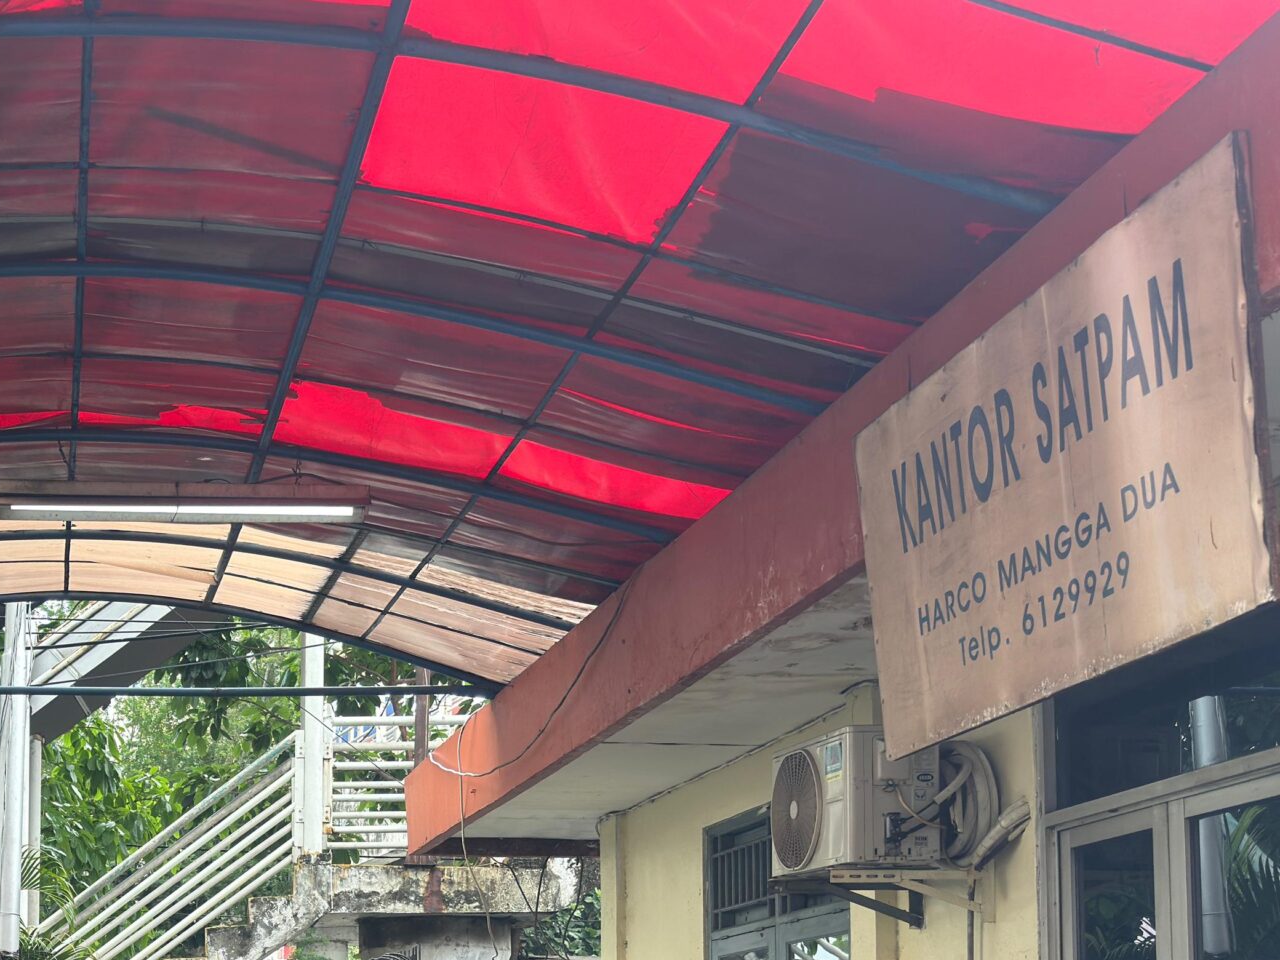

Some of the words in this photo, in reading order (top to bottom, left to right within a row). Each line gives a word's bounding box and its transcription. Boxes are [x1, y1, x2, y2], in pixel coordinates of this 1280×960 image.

[891, 388, 1021, 554] KANTOR
[1031, 257, 1193, 464] SATPAM
[917, 571, 987, 636] HARCO
[997, 501, 1112, 593] MANGGA
[1120, 461, 1181, 524] DUA
[958, 625, 1011, 667] Telp.
[1022, 550, 1130, 636] 6129929
